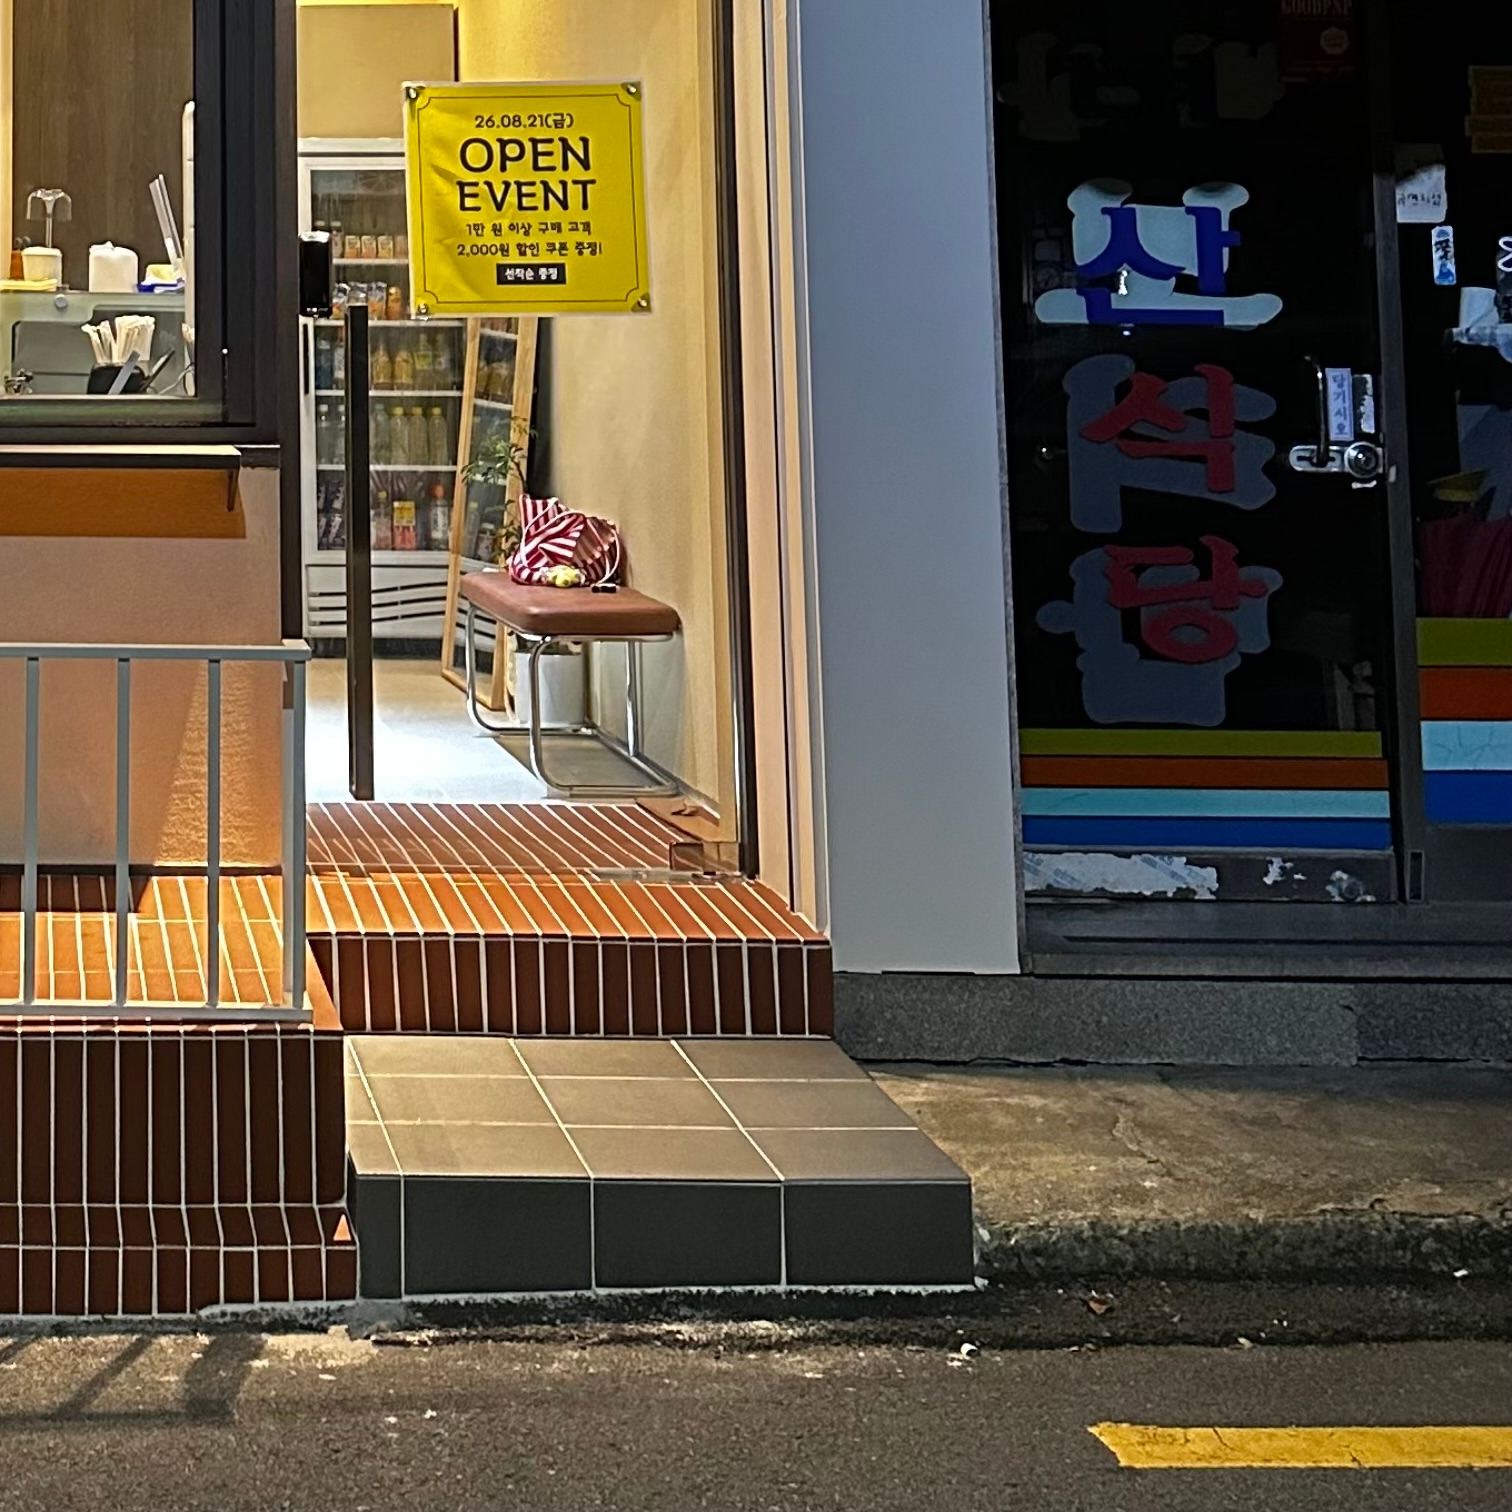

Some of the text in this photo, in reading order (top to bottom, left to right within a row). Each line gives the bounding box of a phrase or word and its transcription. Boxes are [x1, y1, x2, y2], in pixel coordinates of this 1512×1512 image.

[475, 113, 574, 129] 26.08.21(금)
[459, 136, 591, 173] OPEN
[456, 178, 597, 211] EVENT
[508, 222, 533, 236] 이상
[538, 221, 563, 234] 구매
[568, 221, 591, 235] 고객
[457, 243, 510, 257] 2,000원
[516, 242, 540, 257] 할인
[546, 241, 569, 256] 쿠폰
